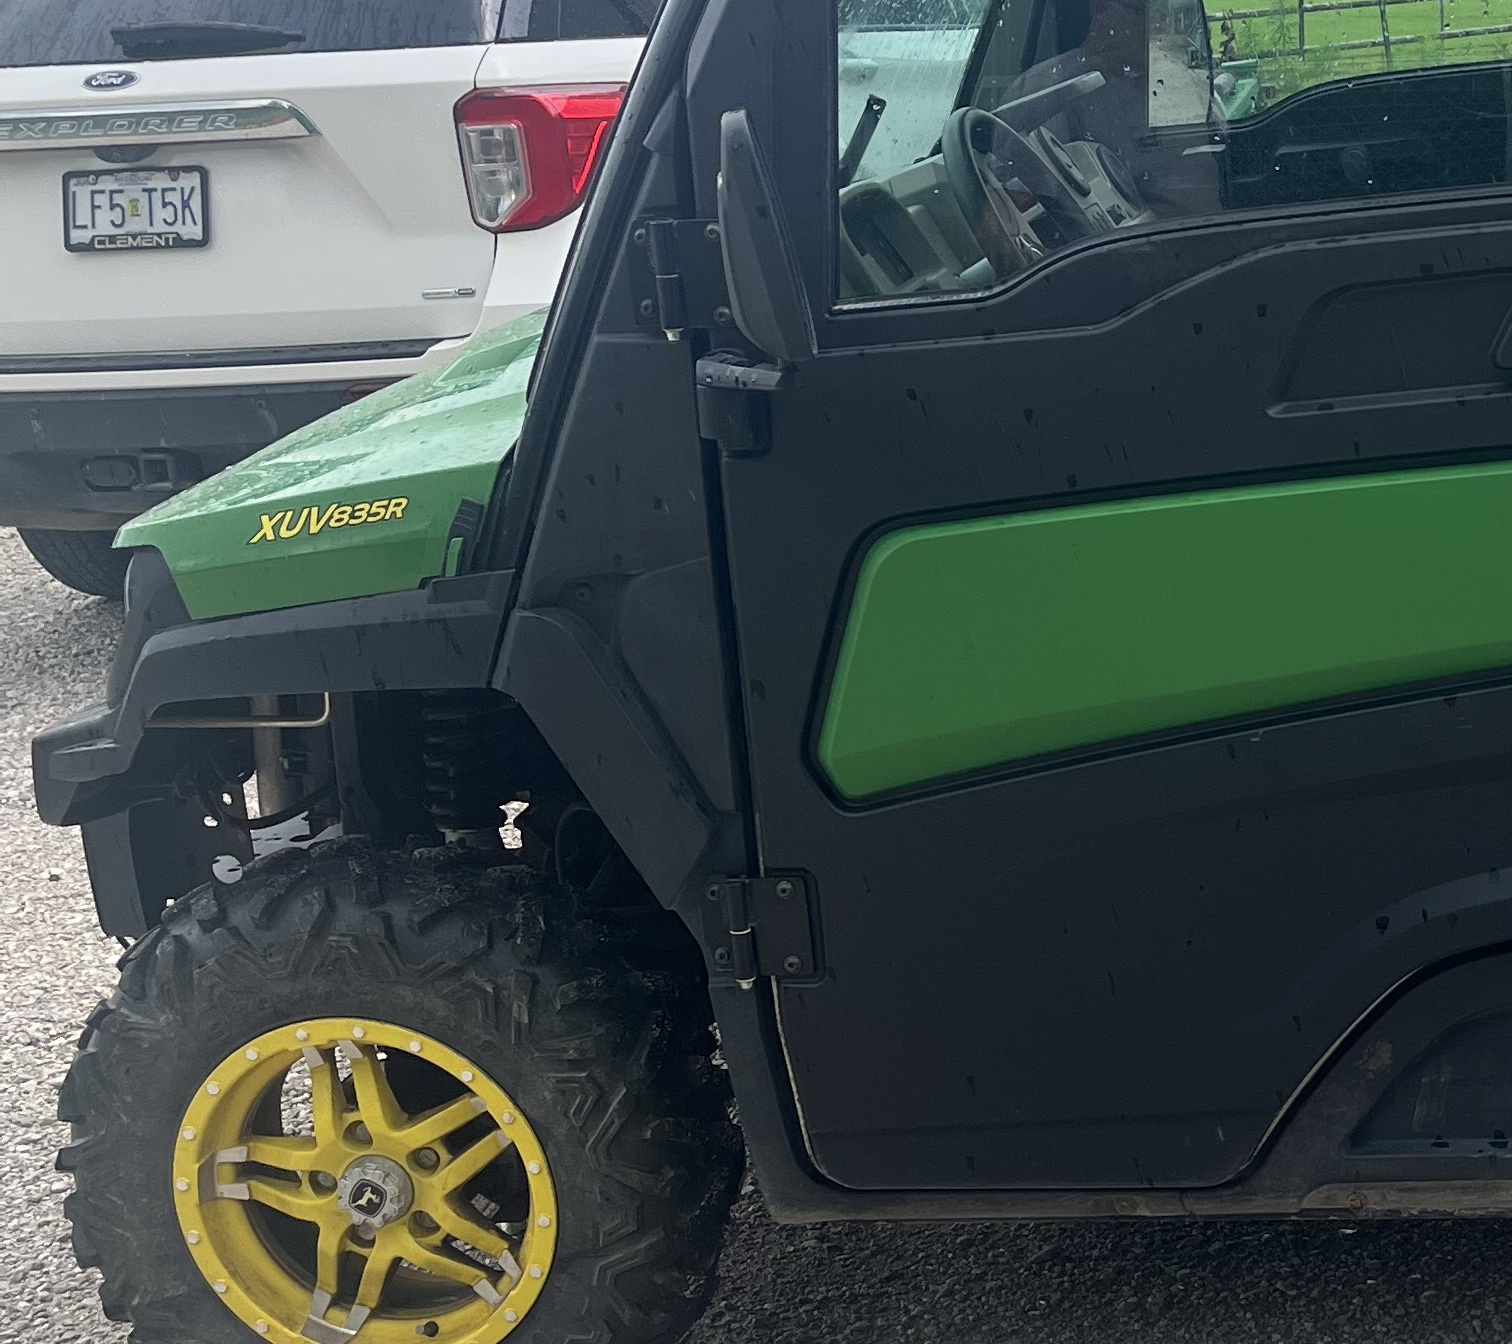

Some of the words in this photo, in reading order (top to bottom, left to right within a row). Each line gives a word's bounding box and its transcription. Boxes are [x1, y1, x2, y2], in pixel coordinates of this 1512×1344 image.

[71, 188, 126, 230] LF5
[141, 186, 198, 227] T5K
[93, 234, 177, 249] CLEMENT
[245, 495, 409, 545] XUV835R
